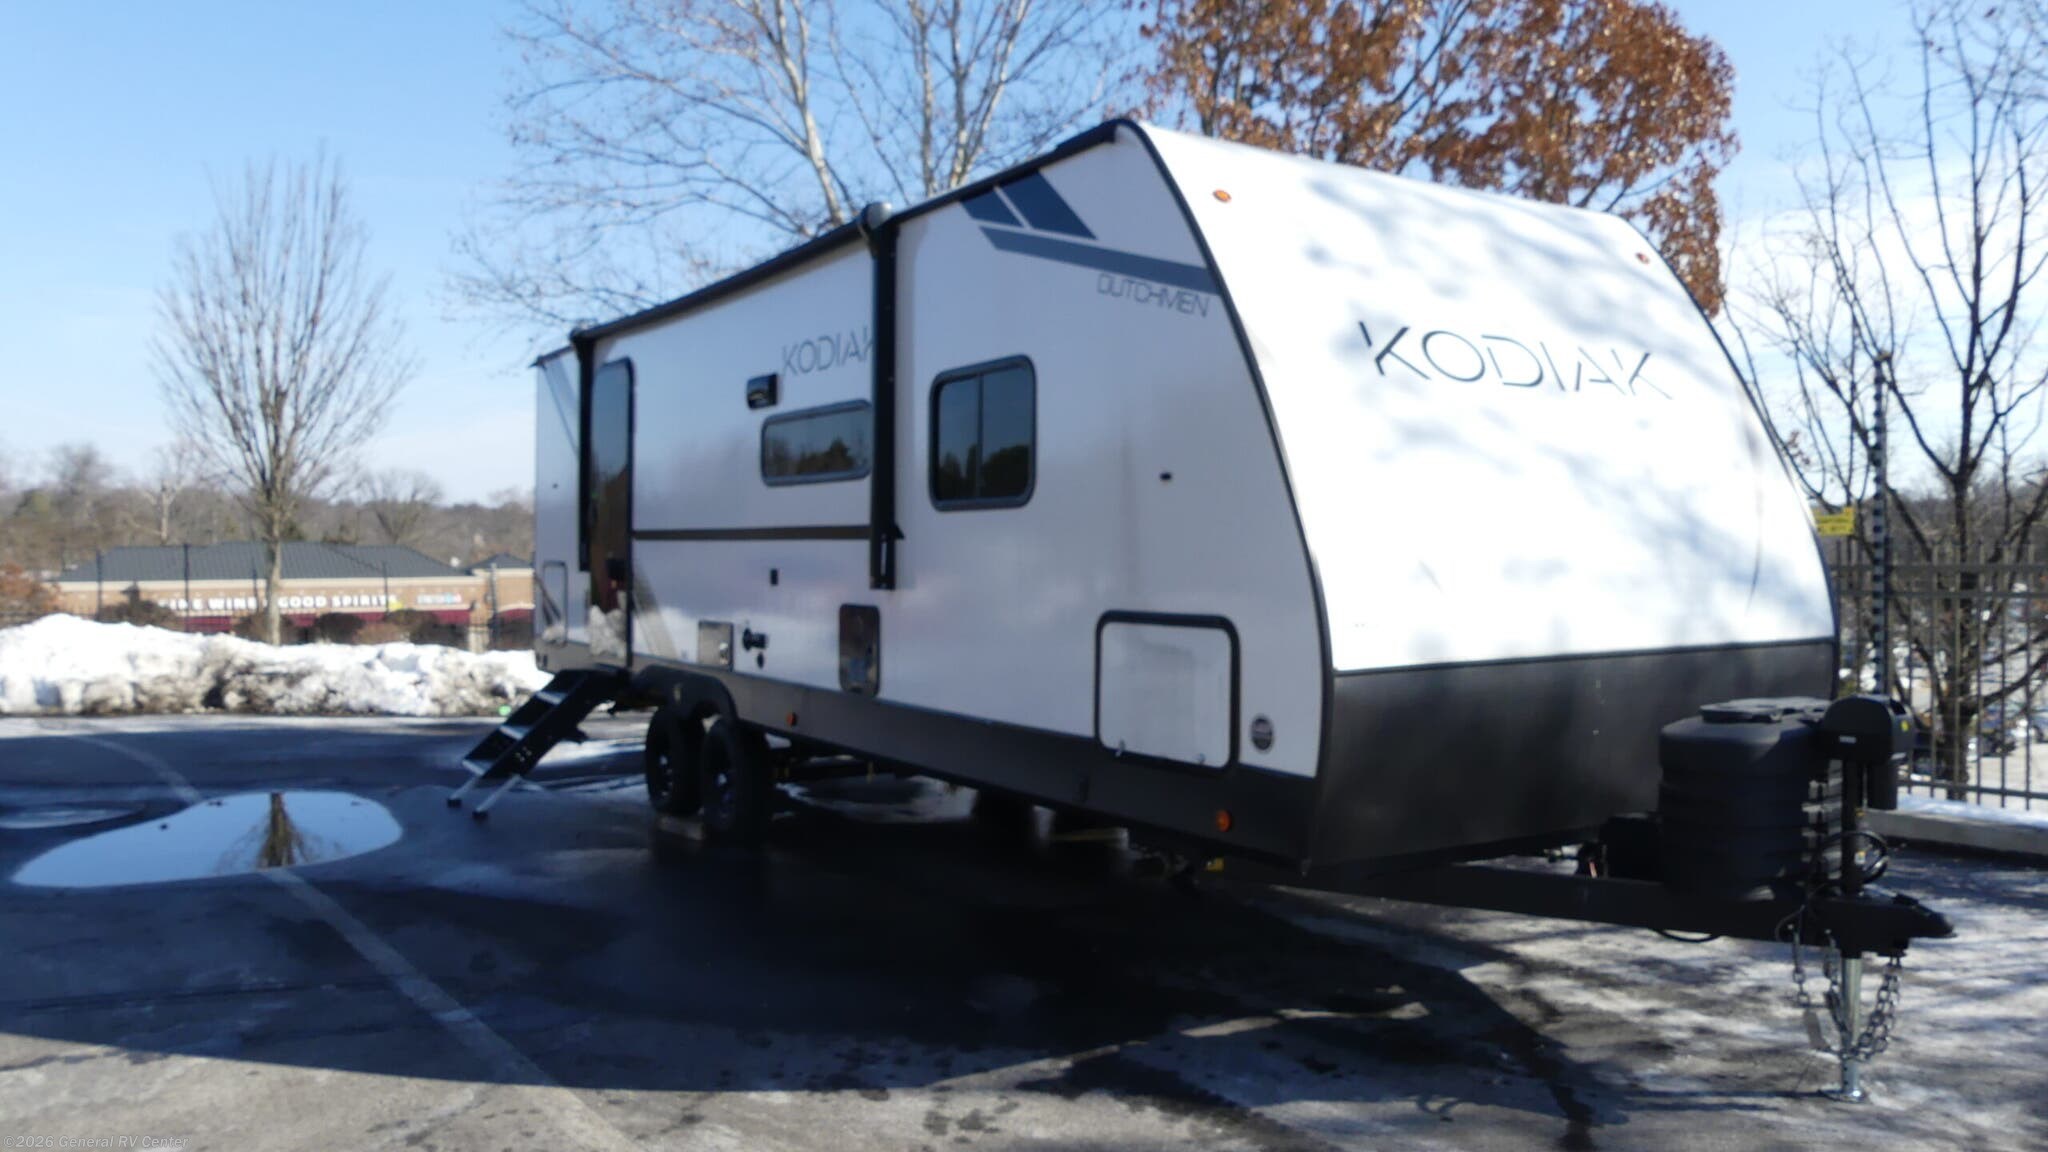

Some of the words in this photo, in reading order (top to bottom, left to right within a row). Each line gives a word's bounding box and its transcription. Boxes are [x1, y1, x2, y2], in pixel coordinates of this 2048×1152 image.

[1096, 272, 1210, 318] DUTCHMEN
[1358, 320, 1673, 400] KODIAK
[277, 595, 328, 609] GOOD
